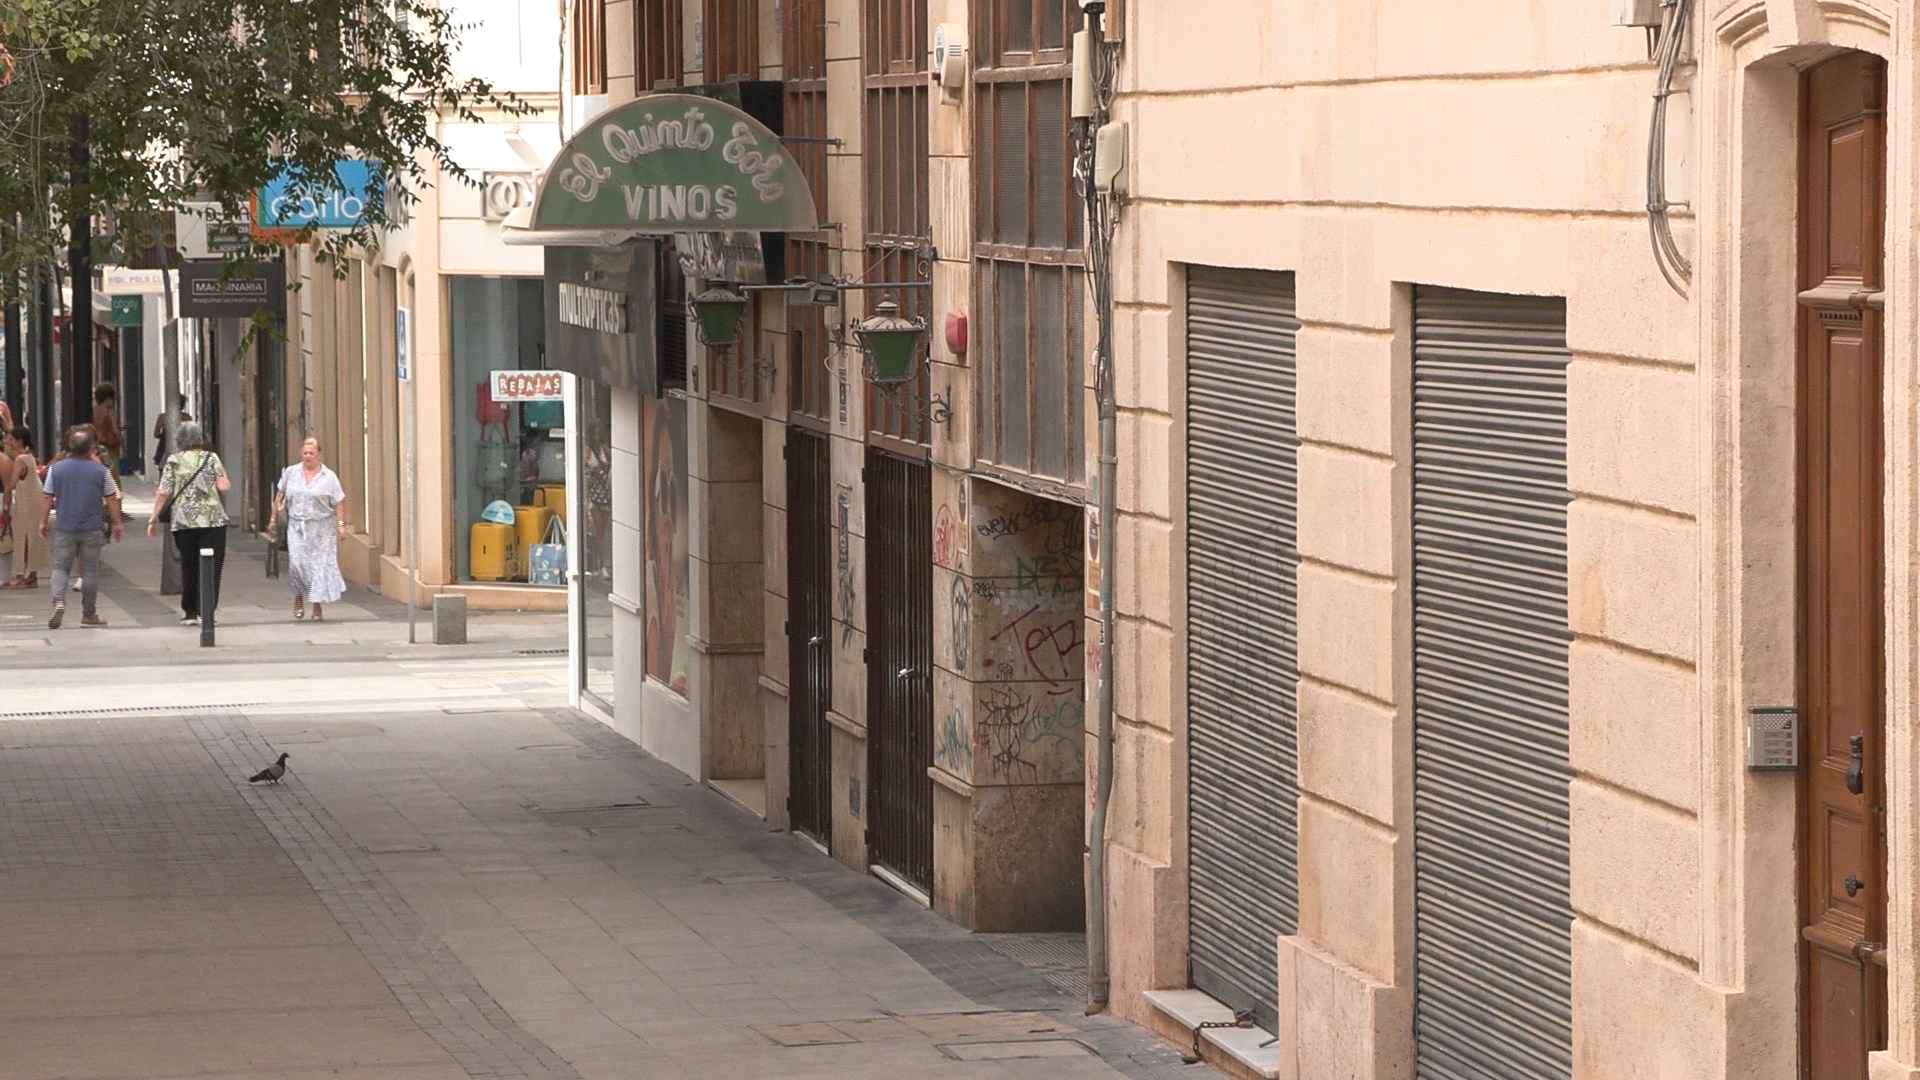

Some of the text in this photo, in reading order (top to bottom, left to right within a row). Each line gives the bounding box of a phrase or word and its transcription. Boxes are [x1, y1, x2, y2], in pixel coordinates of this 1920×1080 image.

[560, 152, 611, 202] El
[602, 107, 714, 164] Quinto
[620, 184, 737, 221] VINOS
[499, 378, 560, 393] REBAJAS
